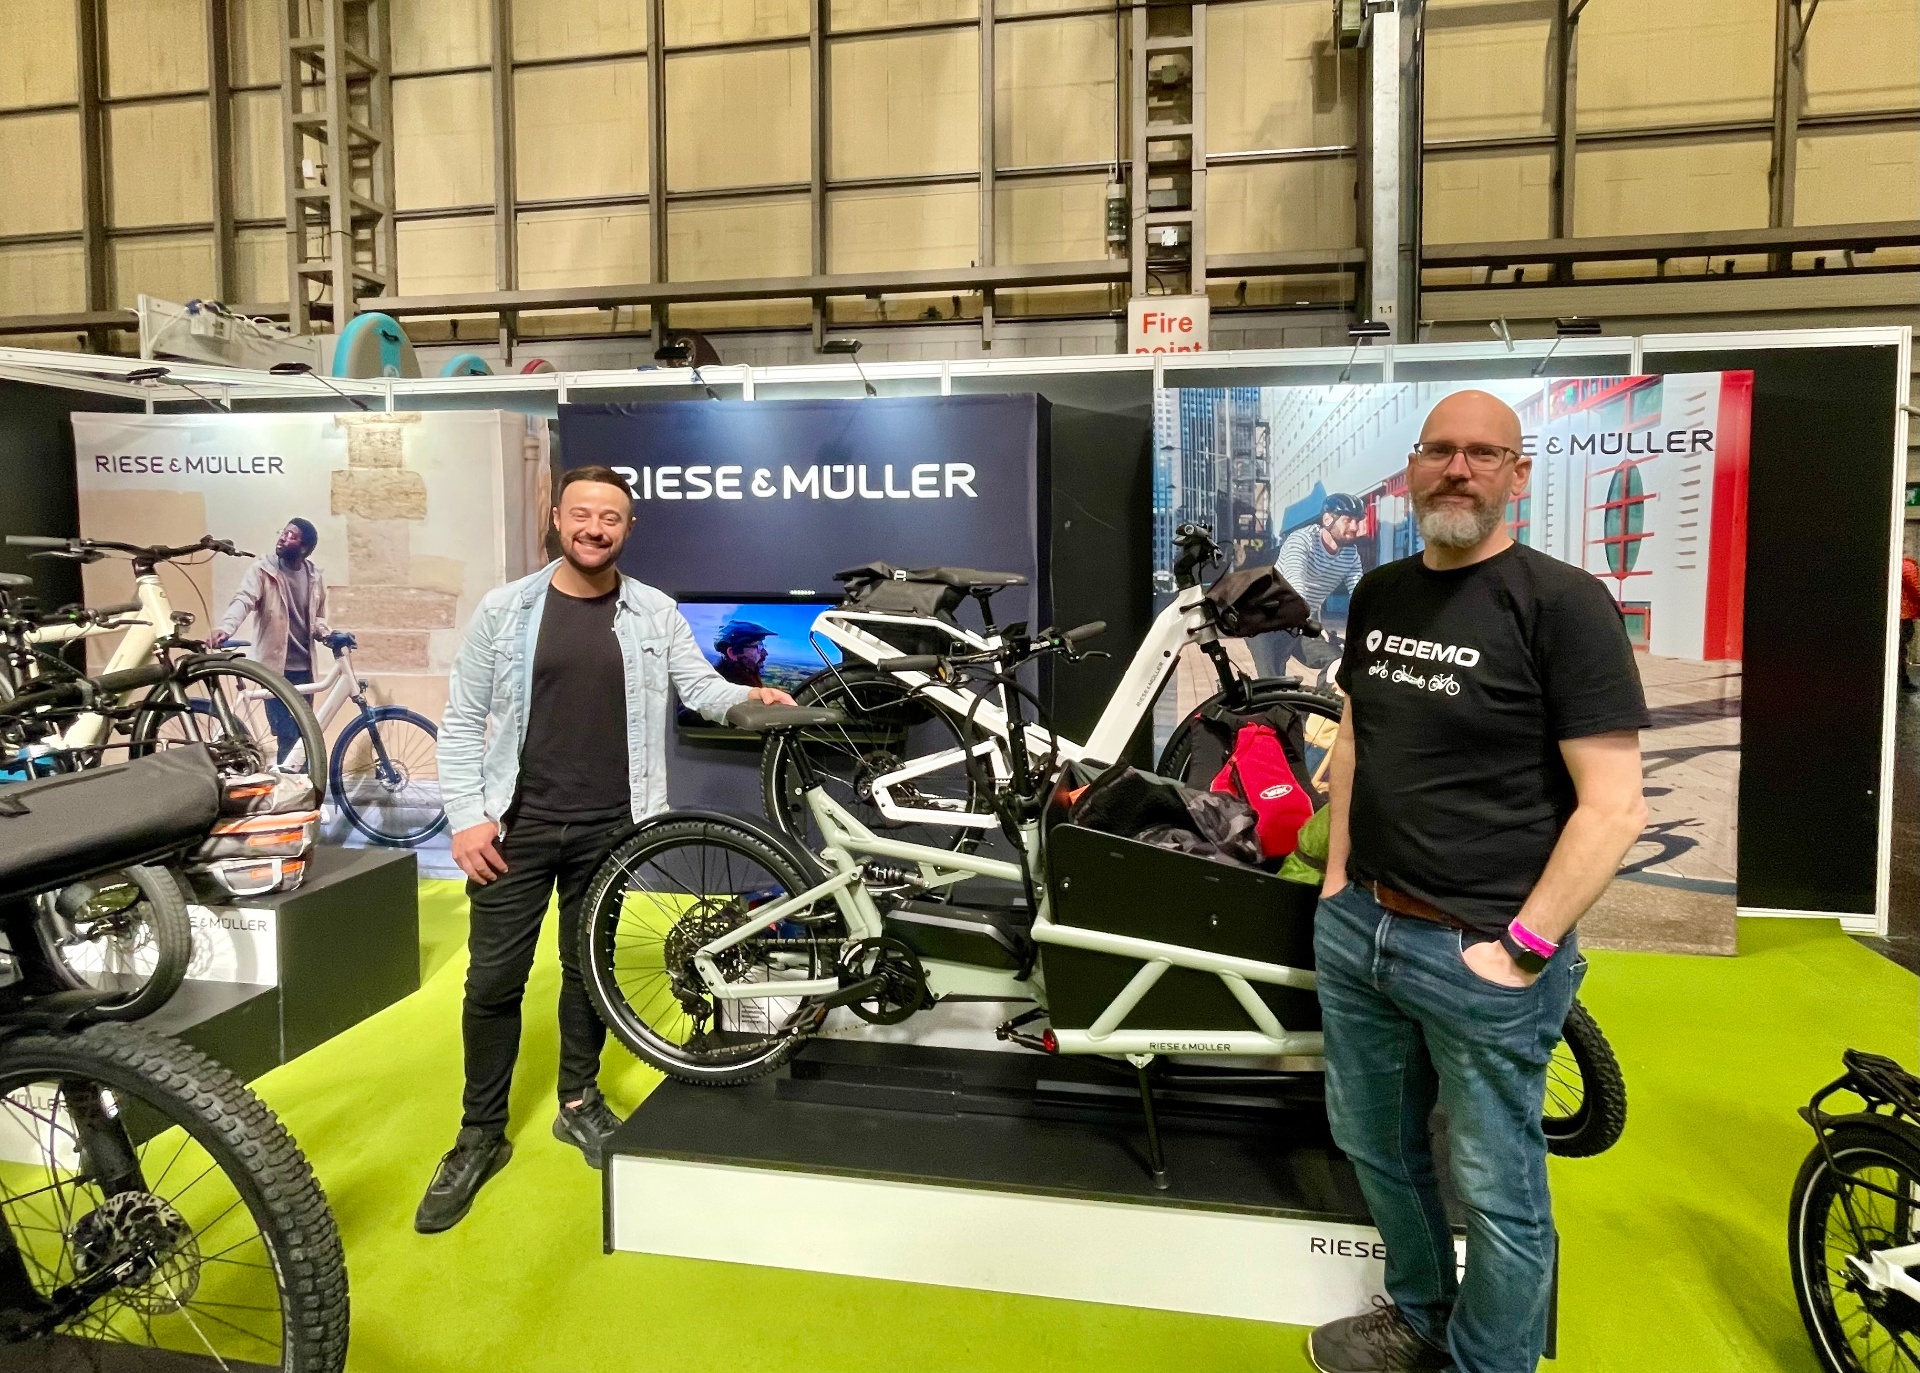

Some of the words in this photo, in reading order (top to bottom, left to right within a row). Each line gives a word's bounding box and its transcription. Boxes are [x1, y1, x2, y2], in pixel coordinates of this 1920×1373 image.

[1379, 305, 1392, 314] 1.1
[1143, 312, 1193, 334] Fire
[1569, 429, 1715, 456] MÜLLER
[95, 455, 165, 474] RIESE
[185, 455, 286, 475] MÜLLER
[783, 462, 979, 500] MÜLLER
[1384, 634, 1481, 668] EDEMO
[1310, 1236, 1386, 1260] RIESE
